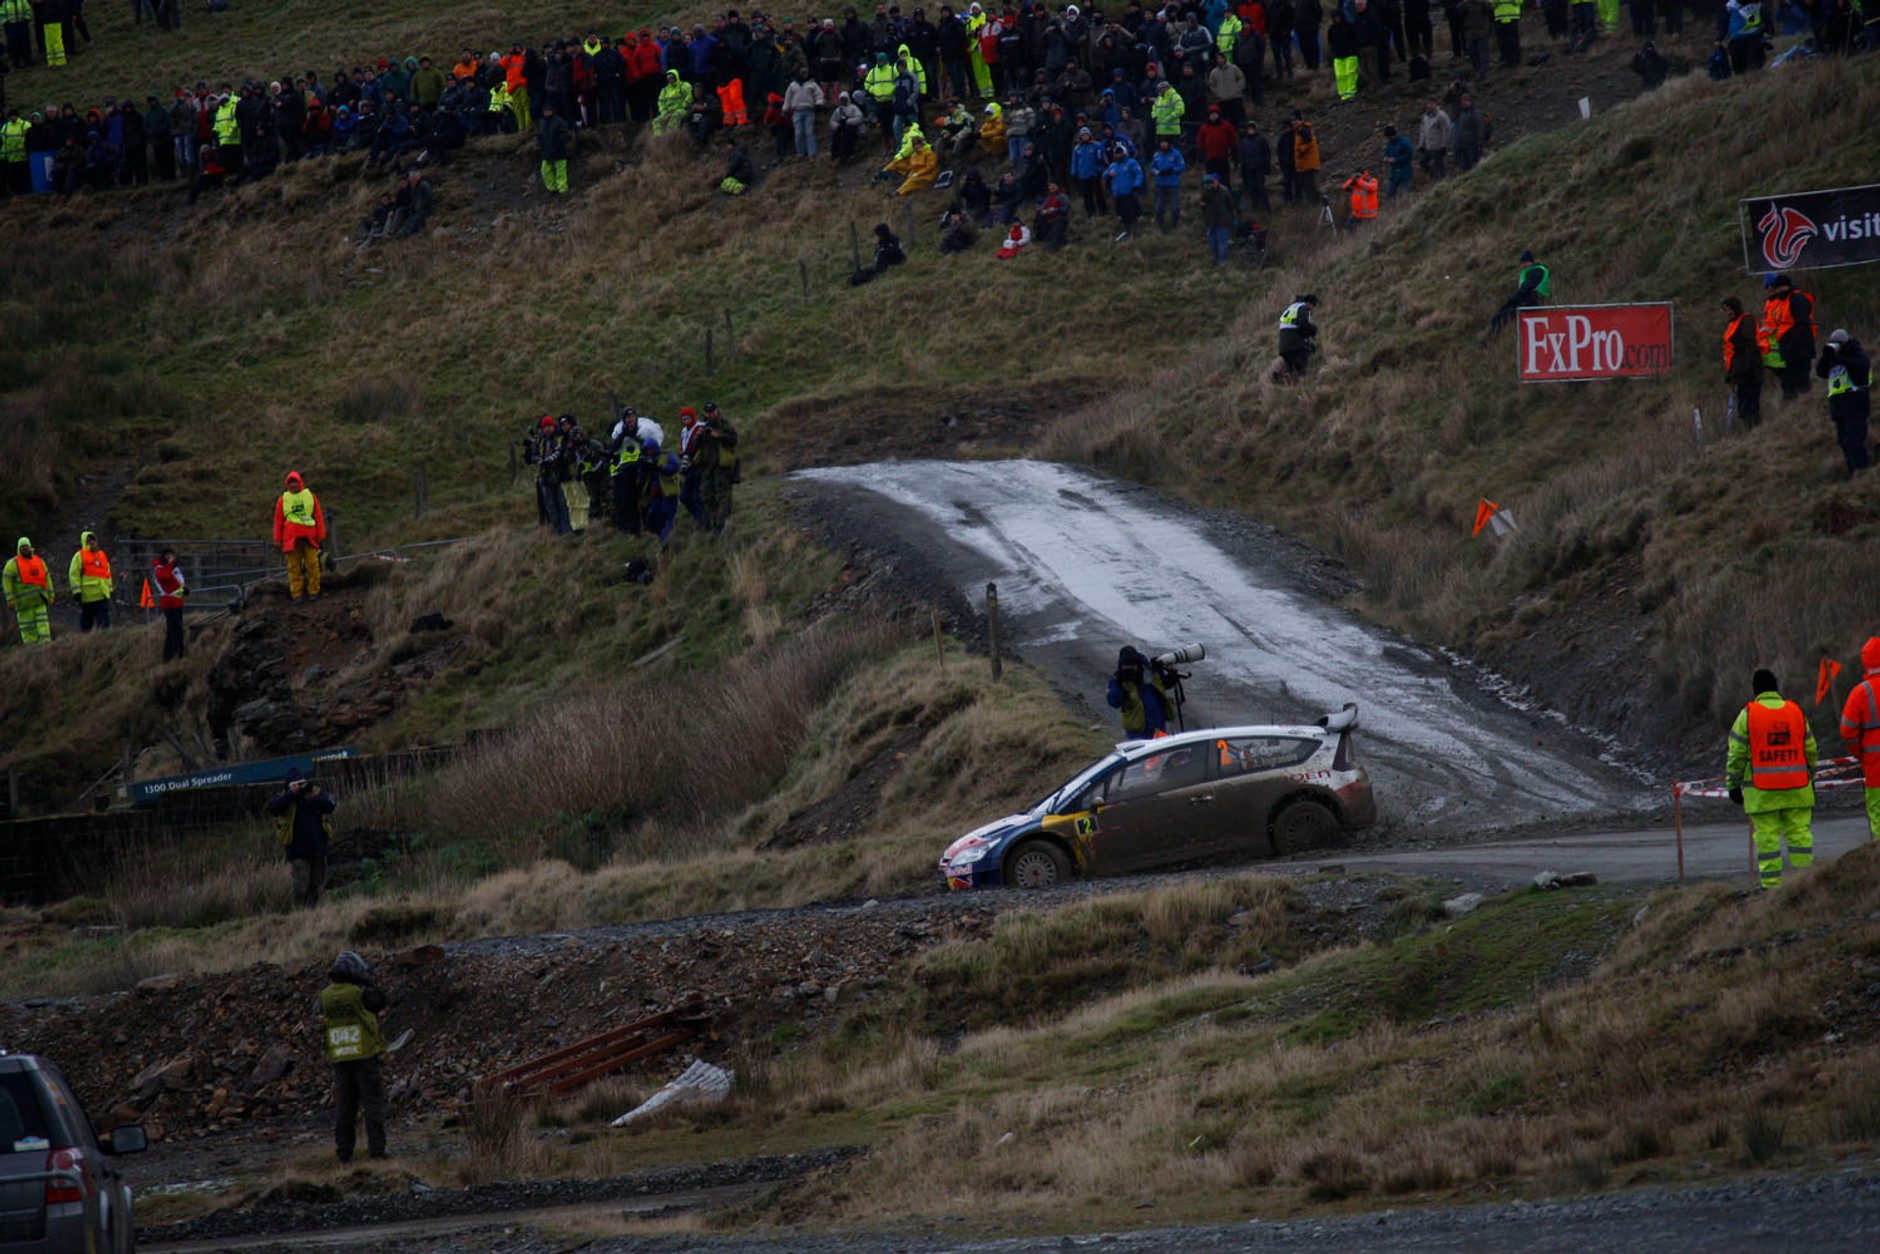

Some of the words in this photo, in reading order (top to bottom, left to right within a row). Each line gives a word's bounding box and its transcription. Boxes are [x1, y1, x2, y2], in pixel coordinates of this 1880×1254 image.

[1823, 212, 1880, 242] visit
[1523, 315, 1667, 374] FxPro.com
[1216, 739, 1232, 767] 2
[1759, 749, 1798, 762] SAFETY
[168, 779, 189, 790] Dual
[191, 772, 232, 788] Spreader
[1082, 818, 1092, 835] 2
